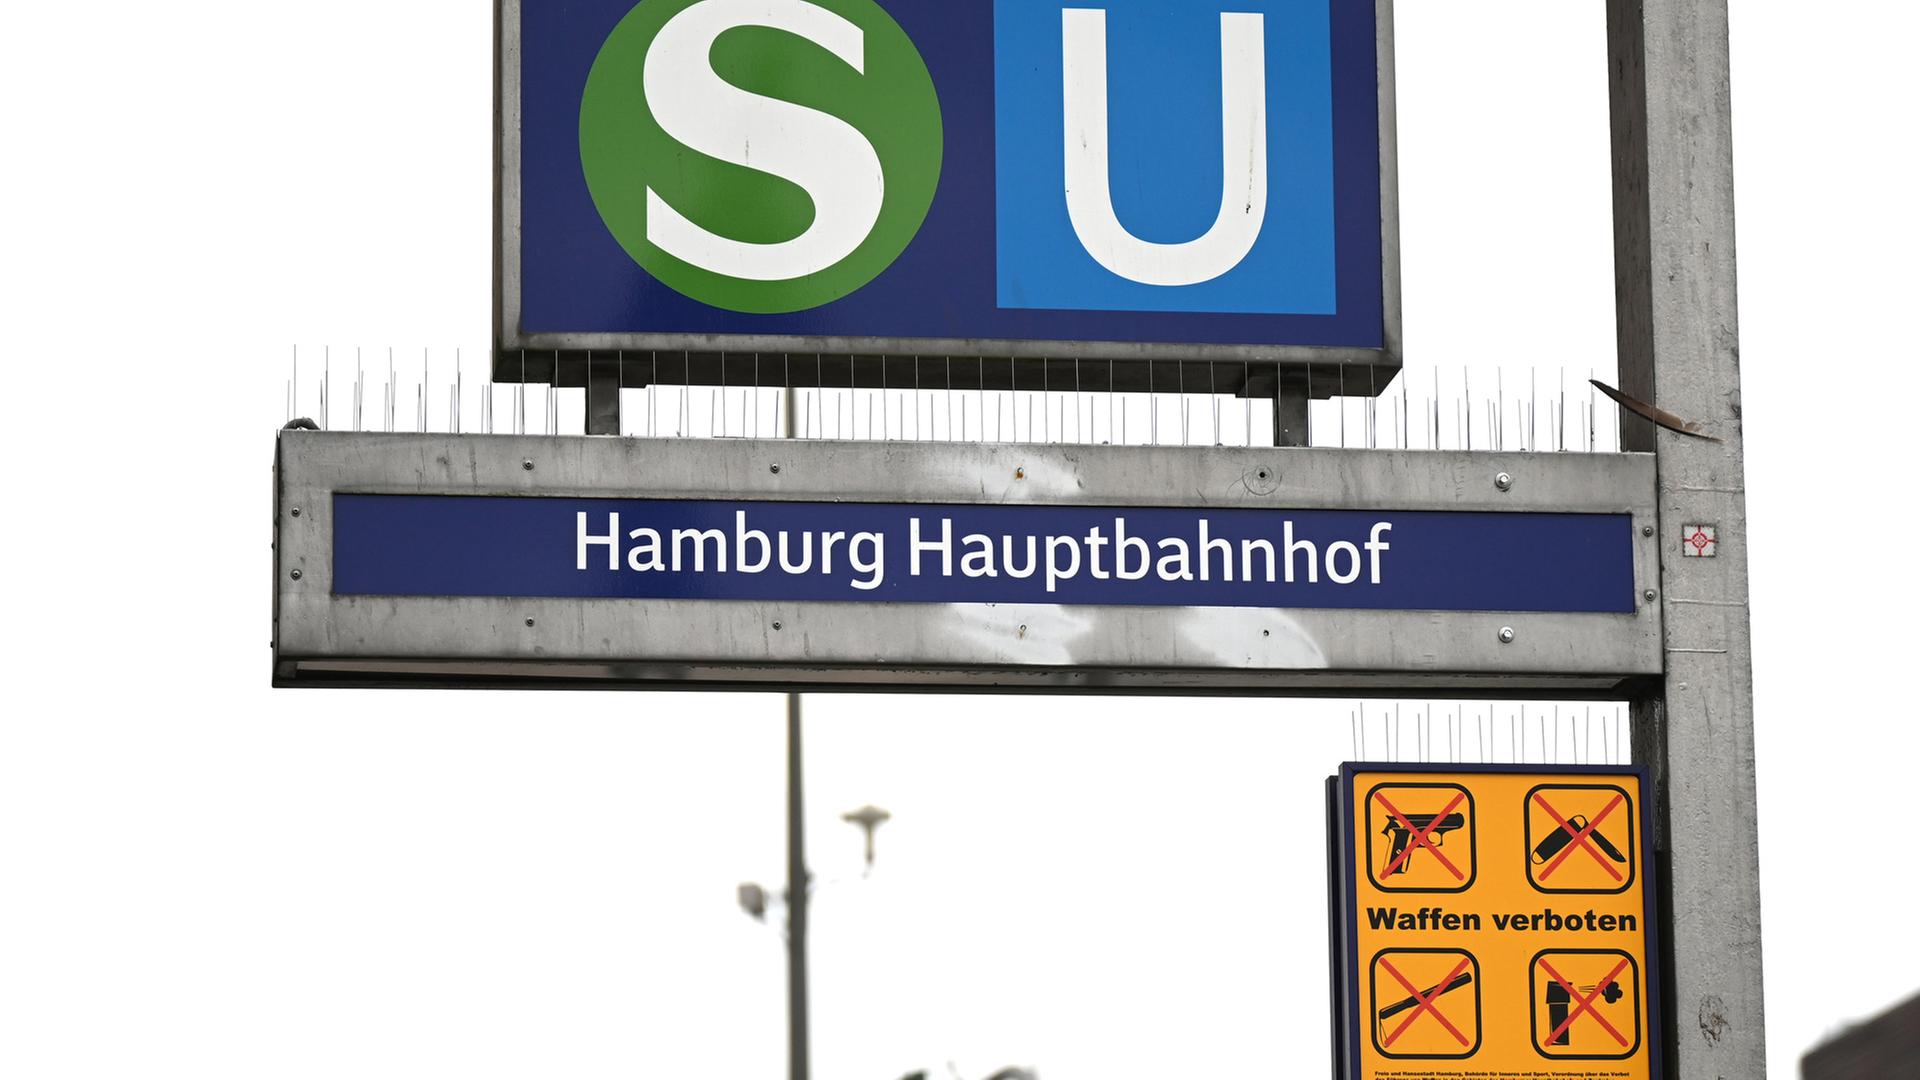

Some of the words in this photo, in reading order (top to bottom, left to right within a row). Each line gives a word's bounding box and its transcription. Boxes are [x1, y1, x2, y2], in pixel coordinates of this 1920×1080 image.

[643, 0, 885, 281] S
[1062, 8, 1267, 286] U
[576, 510, 884, 590] Hamburg
[909, 517, 1393, 593] Hauptbahnhof
[1366, 907, 1481, 931] Waffen
[1492, 908, 1637, 932] verboten
